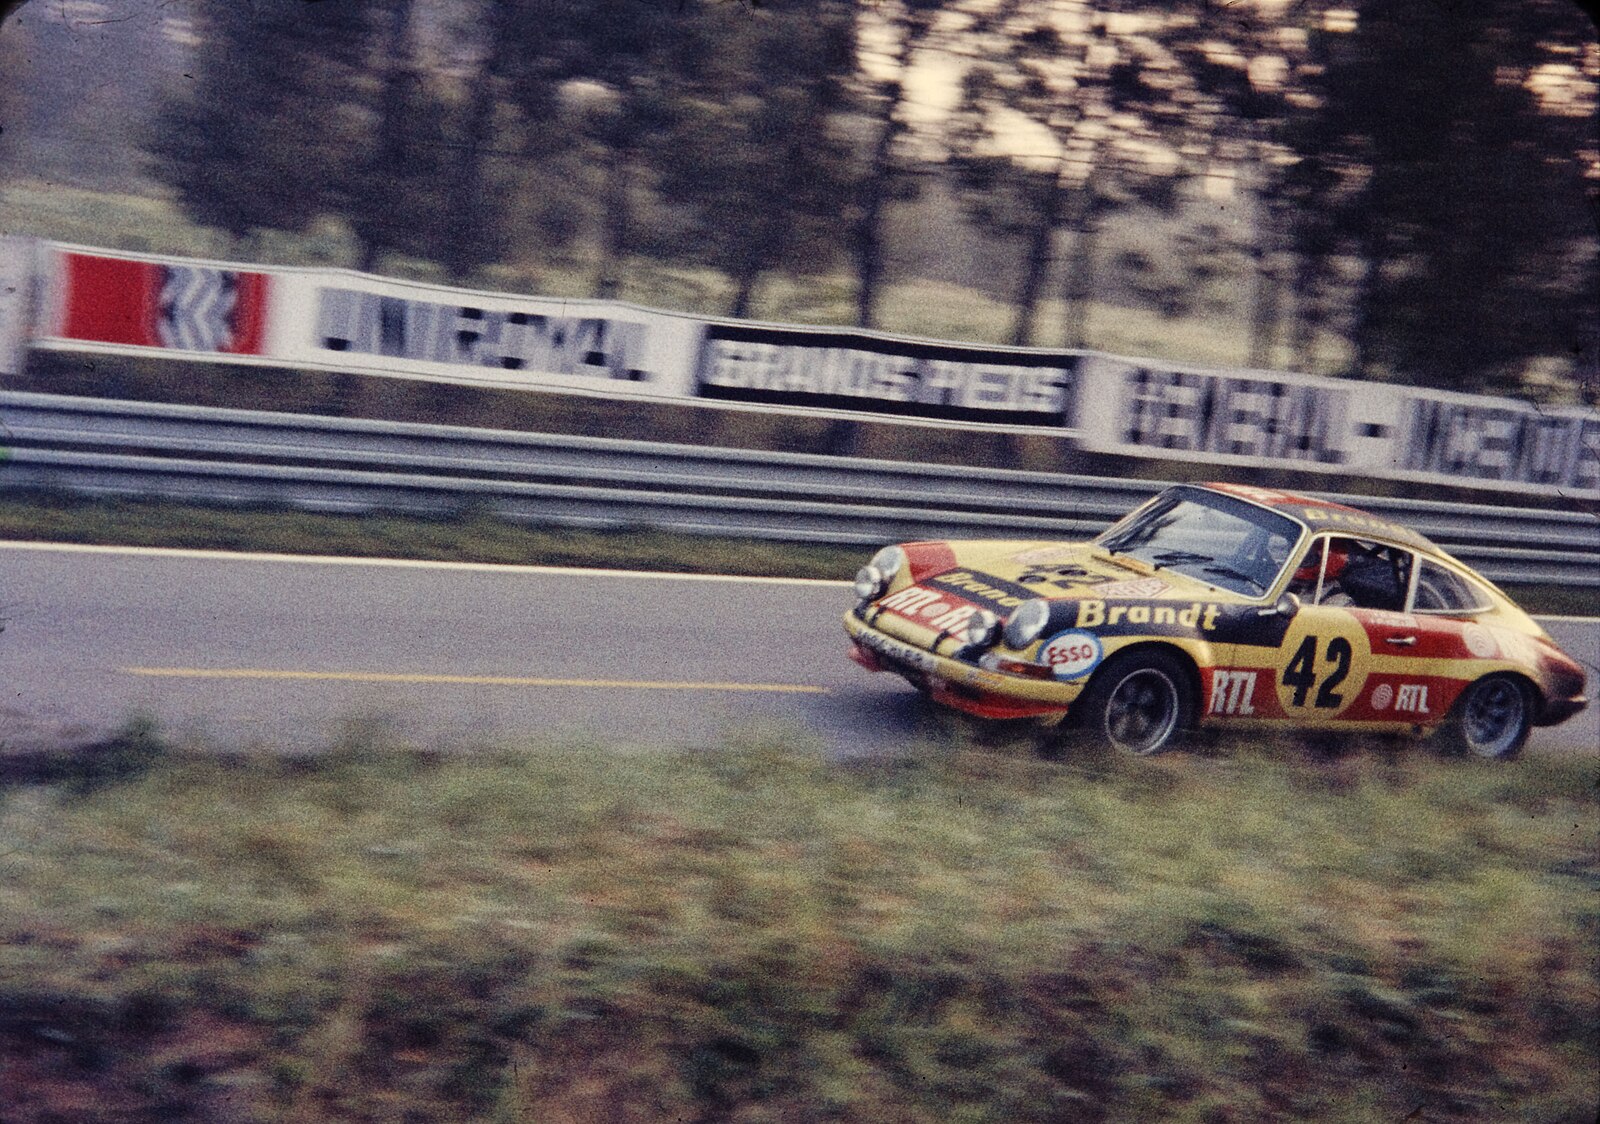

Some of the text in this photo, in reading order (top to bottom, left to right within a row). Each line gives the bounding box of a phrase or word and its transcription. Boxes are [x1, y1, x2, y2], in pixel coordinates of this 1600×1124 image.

[1075, 599, 1221, 631] Brandt
[1281, 634, 1353, 709] 42
[1208, 669, 1258, 716] RTL
[1394, 683, 1430, 714] RTL
